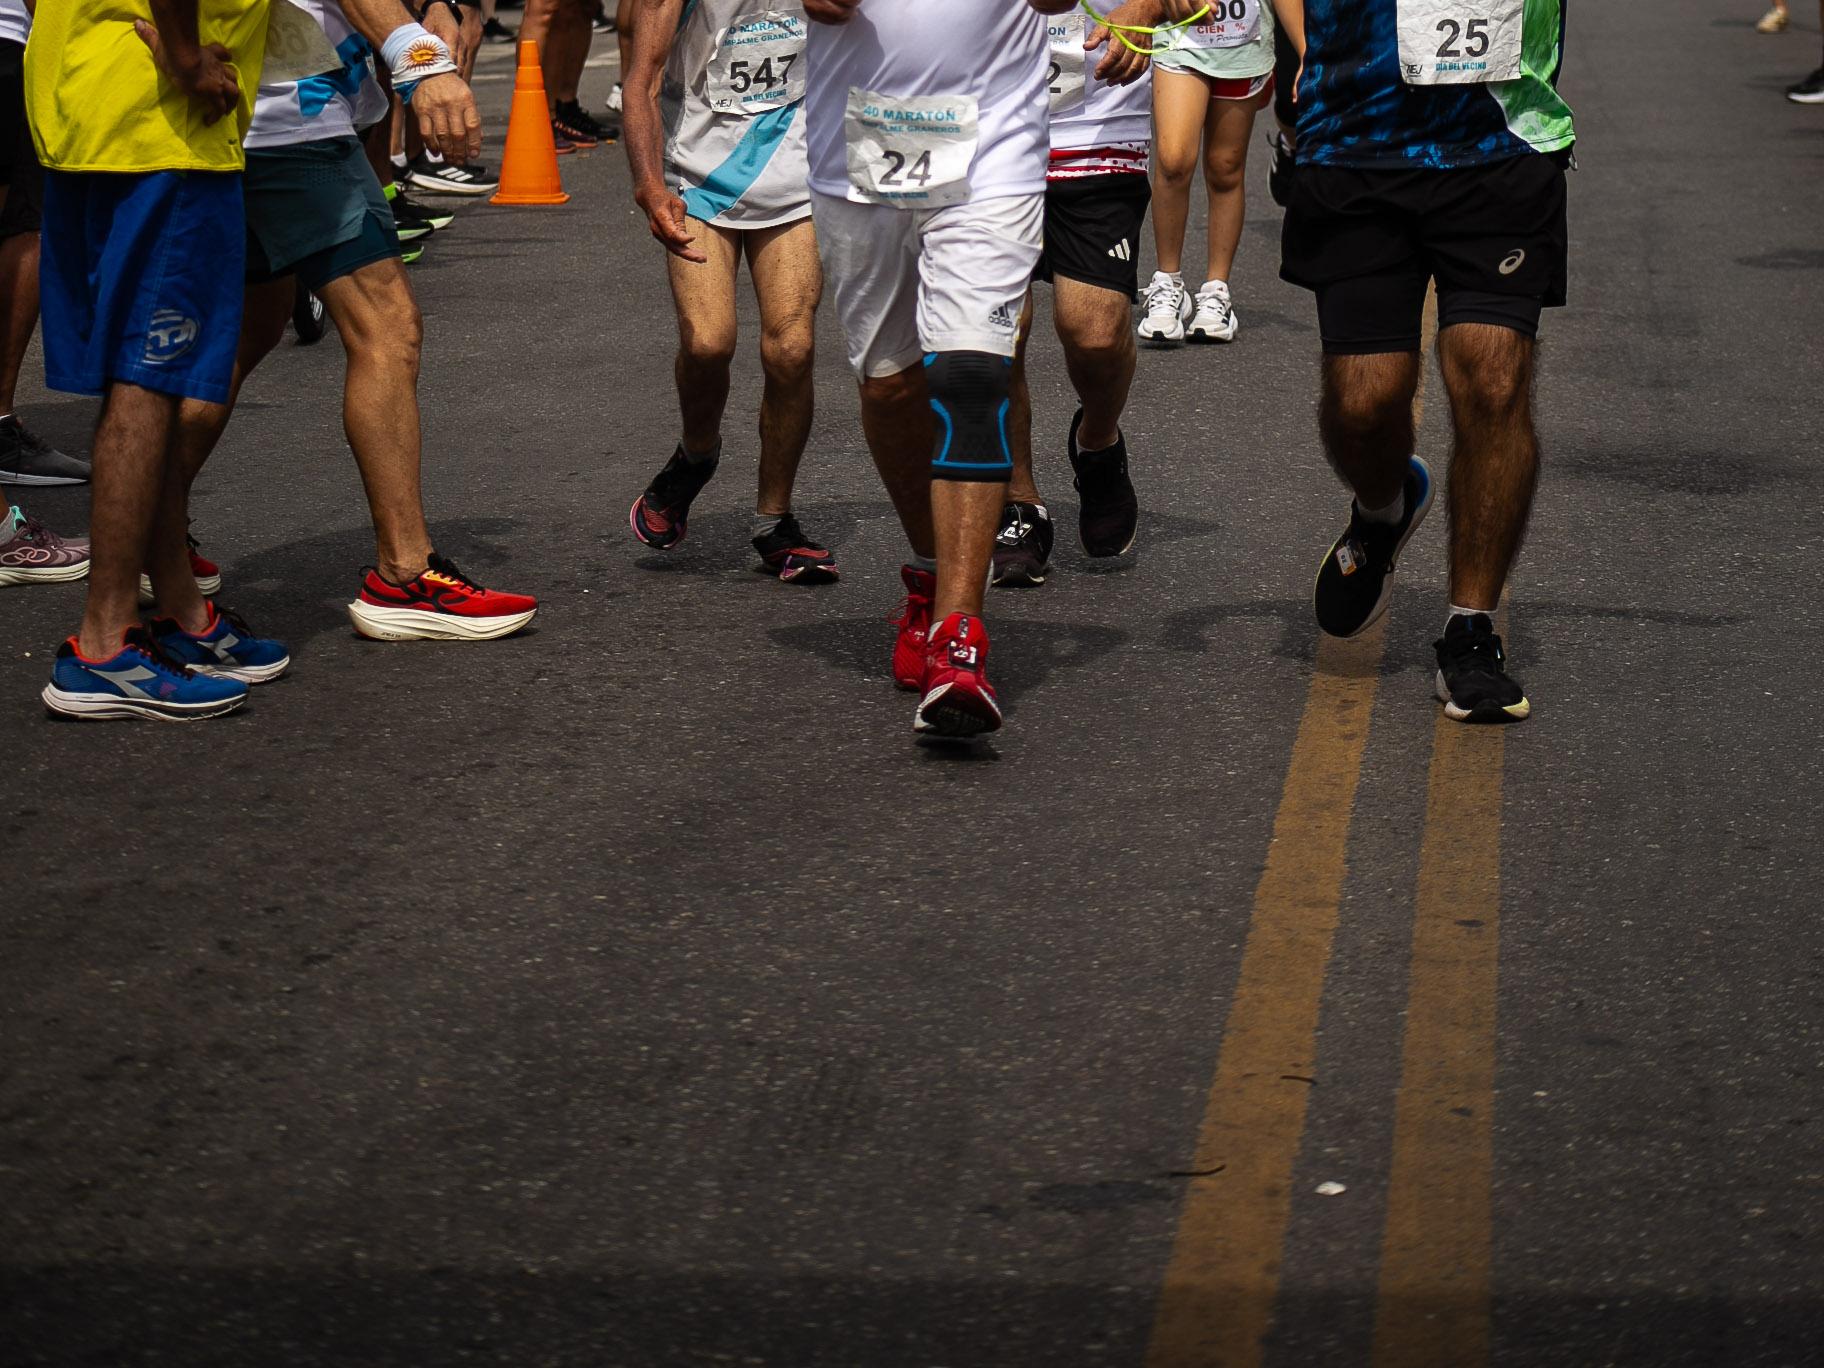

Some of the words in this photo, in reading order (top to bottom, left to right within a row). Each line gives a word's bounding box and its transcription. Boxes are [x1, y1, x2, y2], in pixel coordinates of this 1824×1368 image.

[722, 36, 760, 47] MPALME
[1196, 25, 1225, 34] CIEN
[1435, 18, 1490, 58] 25
[730, 52, 798, 94] 547
[863, 105, 879, 118] 40
[879, 149, 932, 187] 24
